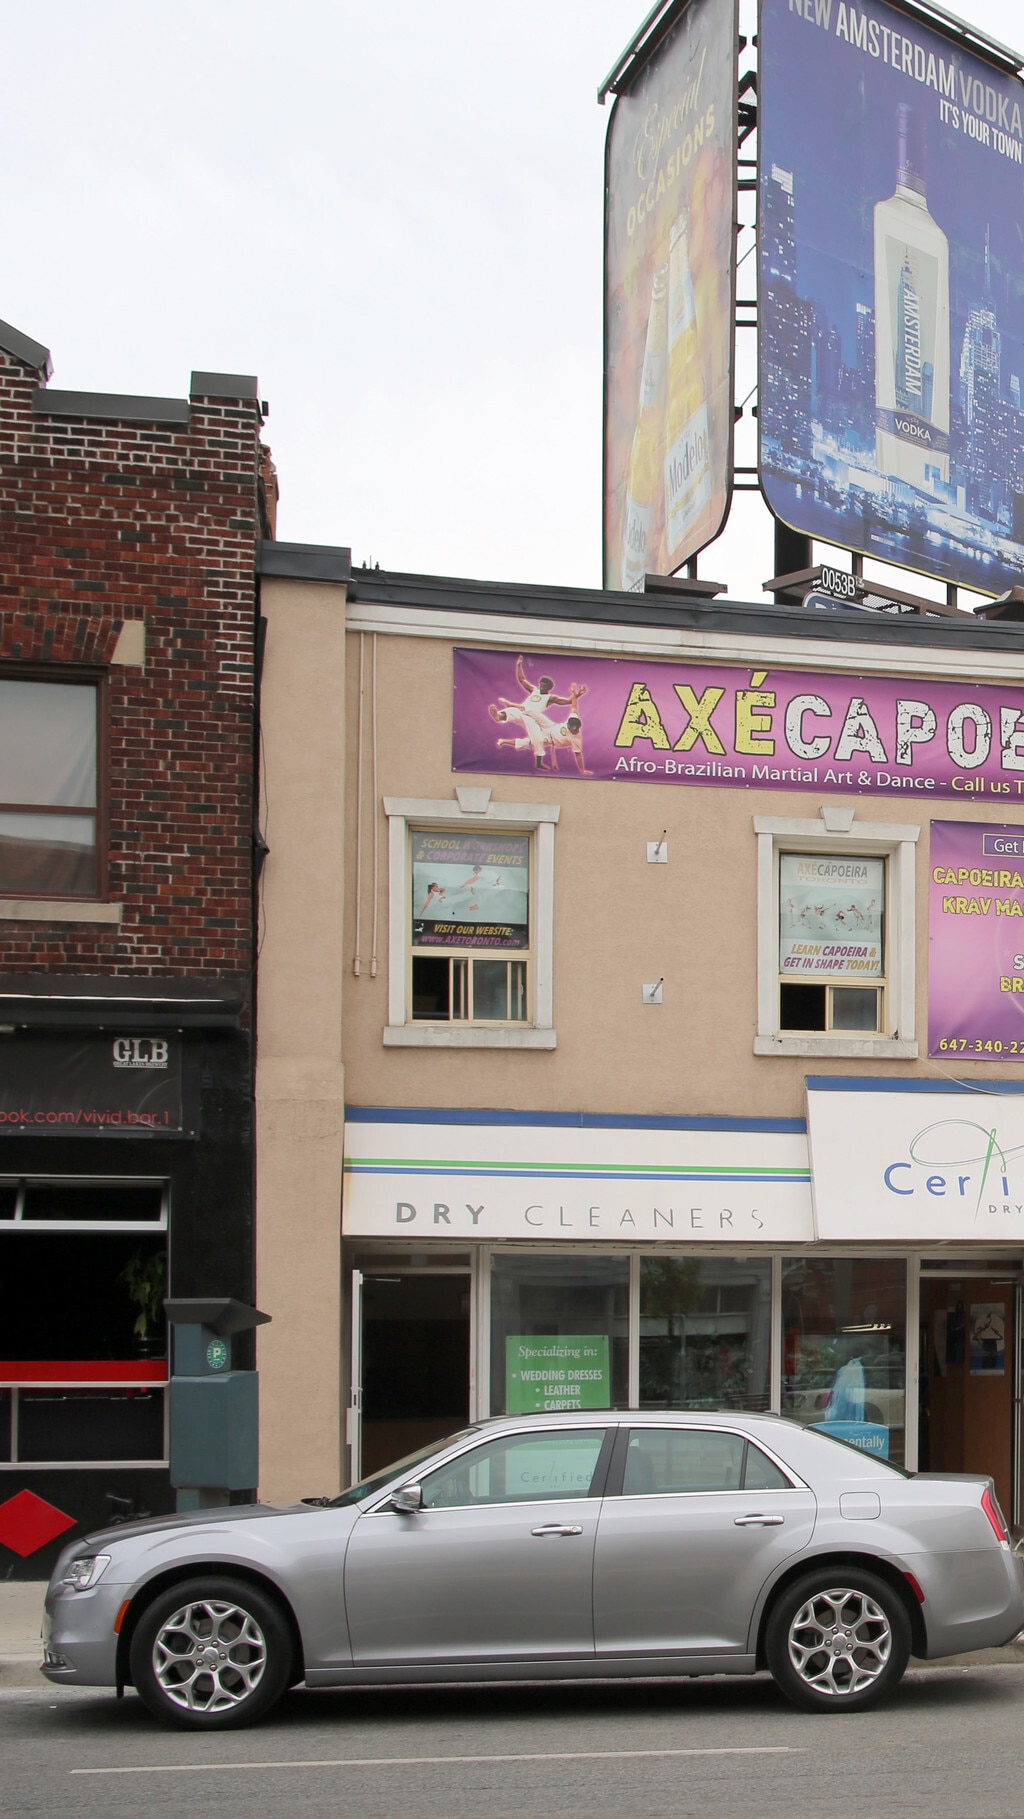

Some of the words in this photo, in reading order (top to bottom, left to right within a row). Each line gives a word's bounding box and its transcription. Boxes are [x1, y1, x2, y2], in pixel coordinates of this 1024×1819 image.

[835, 2, 955, 100] AMSTERDAM
[959, 70, 1023, 139] VODKA
[940, 98, 960, 129] IT'S
[961, 110, 990, 147] YOUR
[992, 127, 1022, 164] TOWN
[627, 104, 715, 236] OCCASIONS
[903, 287, 922, 396] AMSTERDAM
[894, 417, 932, 442] VODKA
[669, 431, 703, 501] Modelo
[822, 567, 856, 597] 0053B
[615, 756, 746, 780] Afro-Brazilian
[752, 765, 818, 783] Martial
[823, 768, 853, 785] Art
[857, 771, 872, 786] &
[876, 771, 935, 790] Dance
[951, 776, 985, 792] Call
[990, 782, 1011, 794] us
[421, 839, 461, 850] SCHOOL
[994, 839, 1018, 854] Get
[416, 850, 425, 860] &
[426, 851, 486, 862] CORPORATE
[486, 854, 524, 865] EVENTS
[798, 876, 868, 884] TORONTO
[943, 897, 991, 915] KRAV
[434, 924, 456, 934] VISIT
[456, 925, 475, 935] OUR
[475, 926, 514, 936] WEBSITE:
[790, 944, 822, 956] LEARN
[822, 946, 868, 957] CAPOEIRA
[869, 947, 877, 958] &
[783, 957, 802, 968] GET
[802, 958, 814, 969] IN
[814, 959, 846, 970] SHAPE
[845, 960, 880, 971] TODAY!
[113, 1039, 168, 1062] GLB
[396, 1202, 485, 1225] DRY
[524, 1204, 764, 1230] CLEANERS
[989, 1205, 1023, 1214] DRY
[518, 1345, 581, 1359] Specializing
[583, 1346, 598, 1356] in:
[520, 1370, 565, 1381] WEDDING
[568, 1369, 603, 1380] DRESSES
[544, 1385, 581, 1396] LEATHER
[544, 1400, 582, 1411] CARPETS
[844, 1436, 886, 1450] entally
